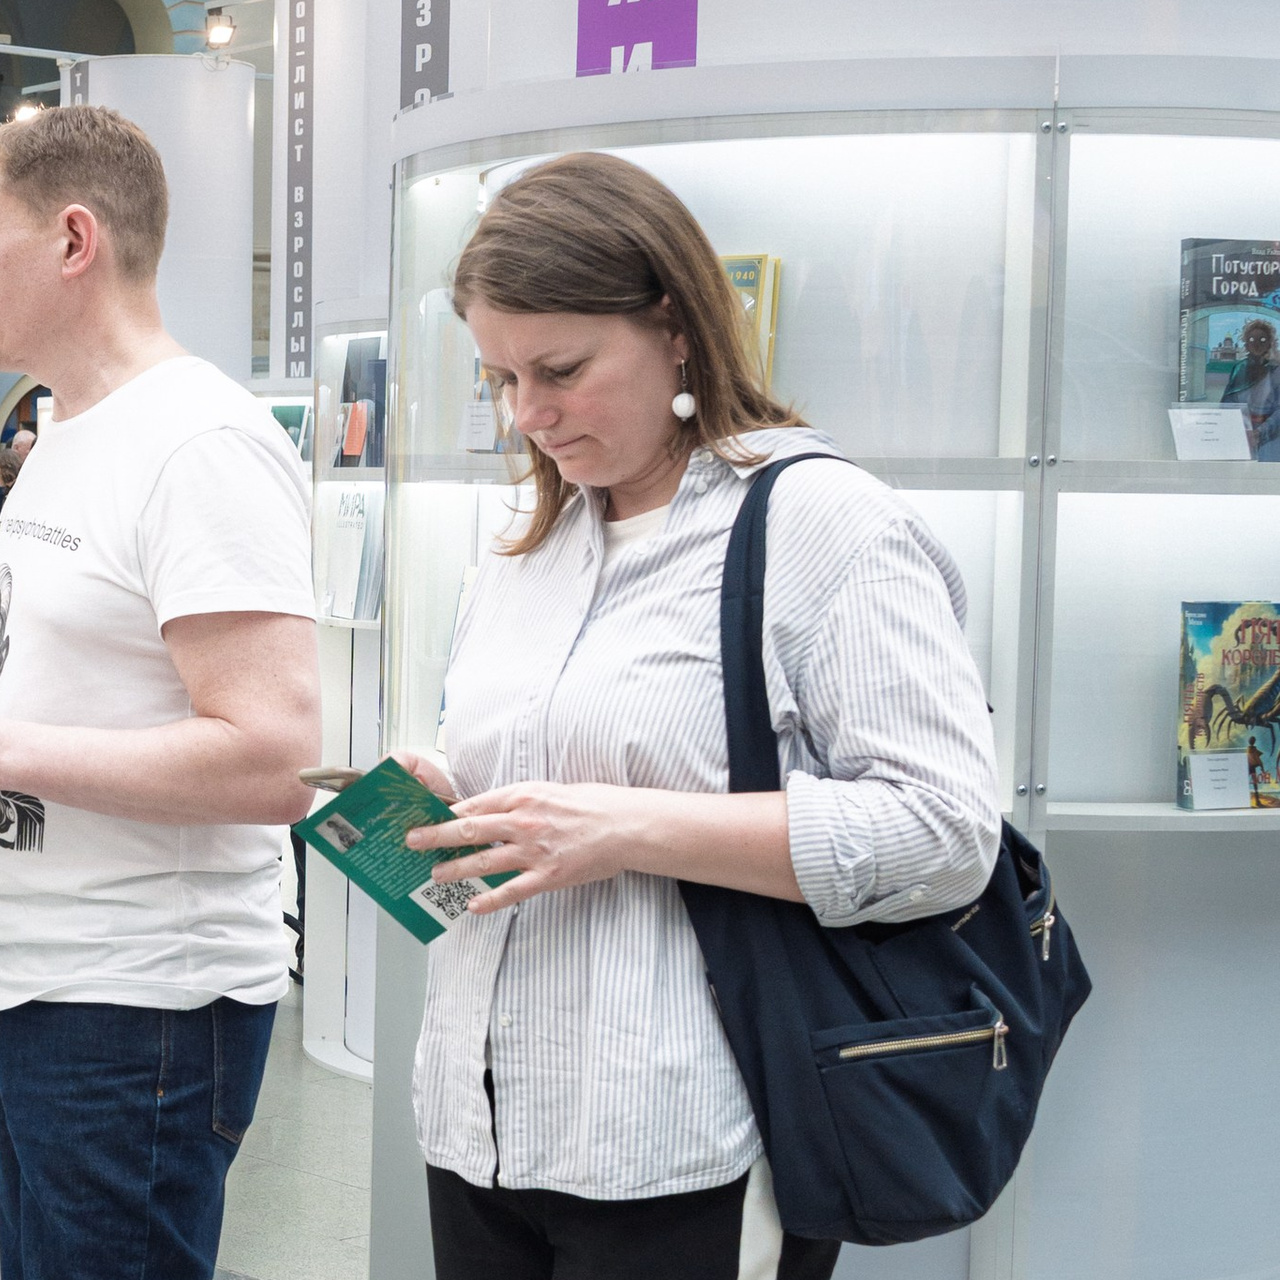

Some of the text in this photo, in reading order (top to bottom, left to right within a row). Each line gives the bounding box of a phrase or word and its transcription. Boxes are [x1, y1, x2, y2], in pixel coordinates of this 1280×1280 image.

[1211, 253, 1280, 275] Потустор
[290, 186, 306, 378] ВЗРОСЛЫМ
[730, 271, 755, 280] 1940
